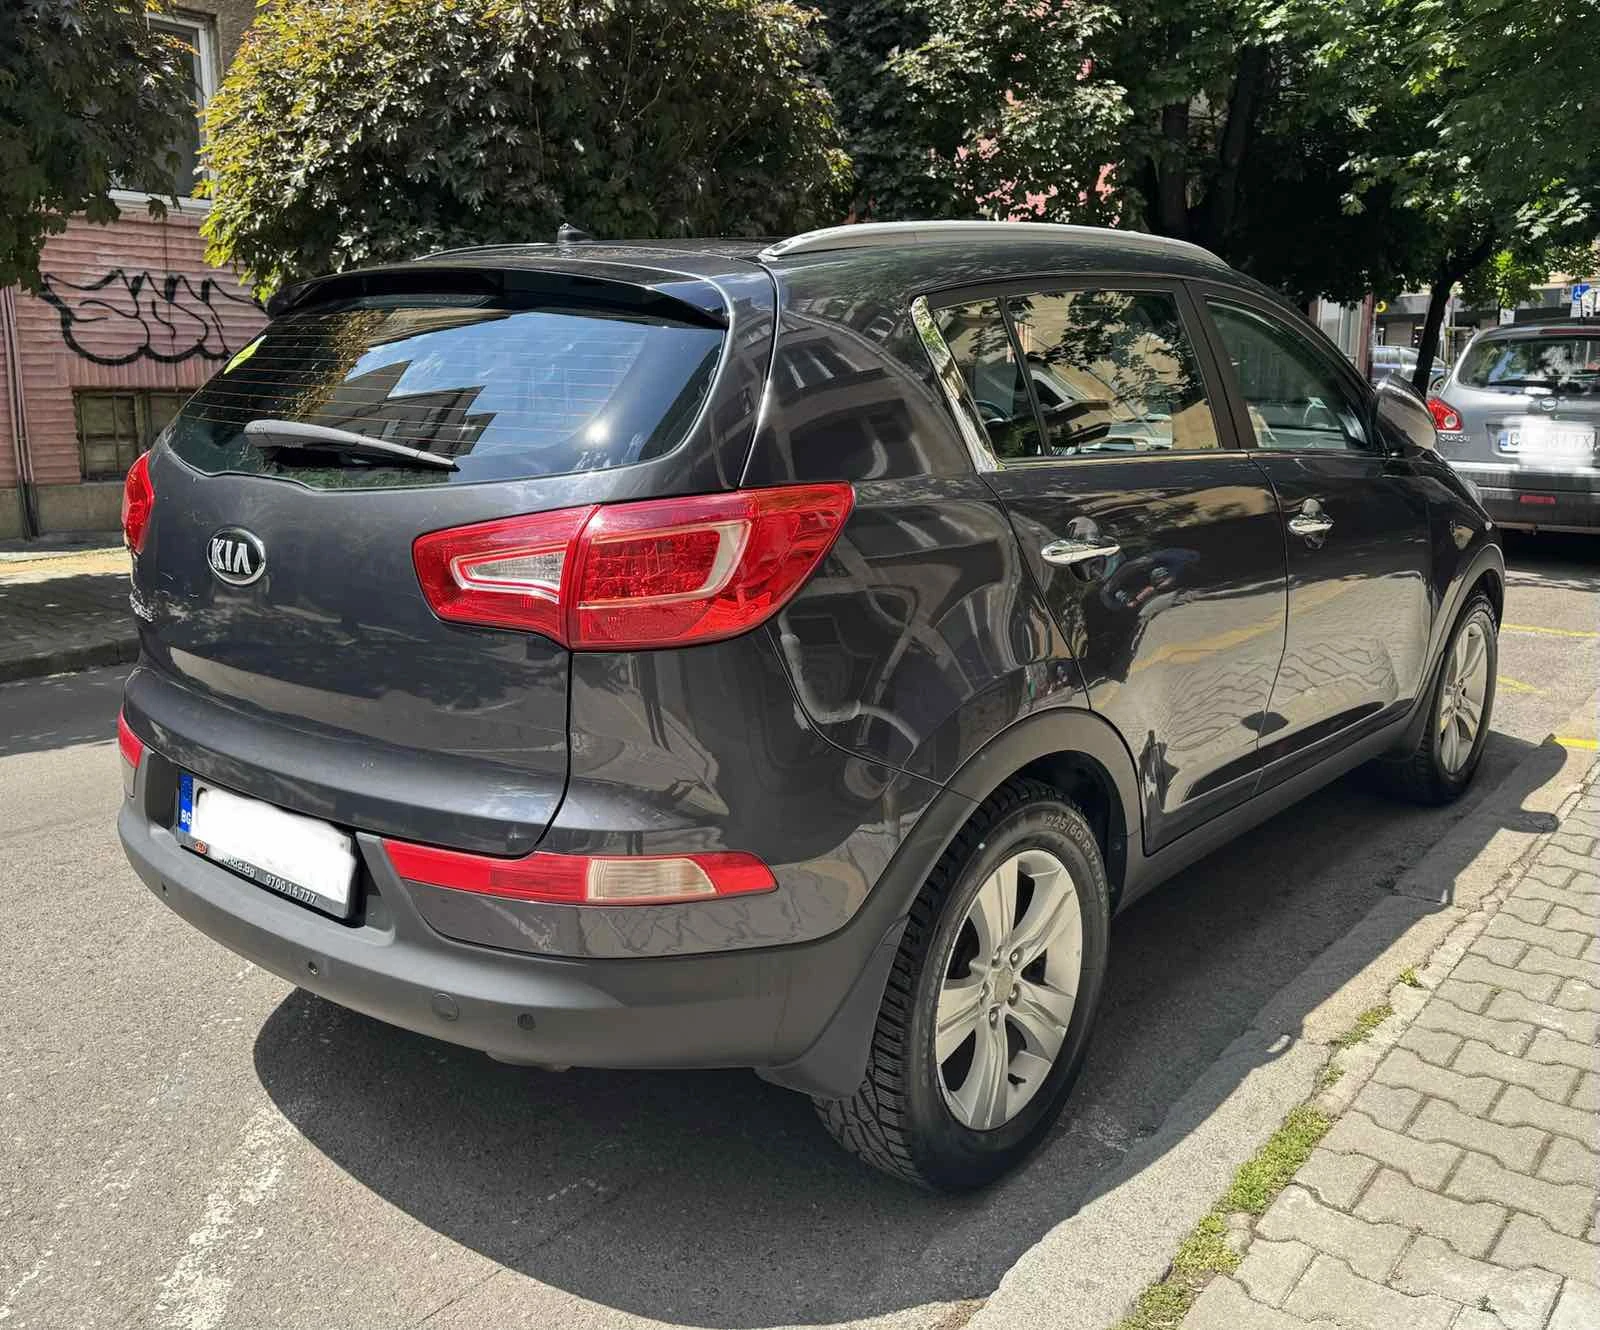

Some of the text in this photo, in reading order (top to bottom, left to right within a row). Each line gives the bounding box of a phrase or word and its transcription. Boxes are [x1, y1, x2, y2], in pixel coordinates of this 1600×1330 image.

[211, 538, 252, 575] KIA
[181, 809, 192, 825] BG
[265, 874, 287, 891] 0700
